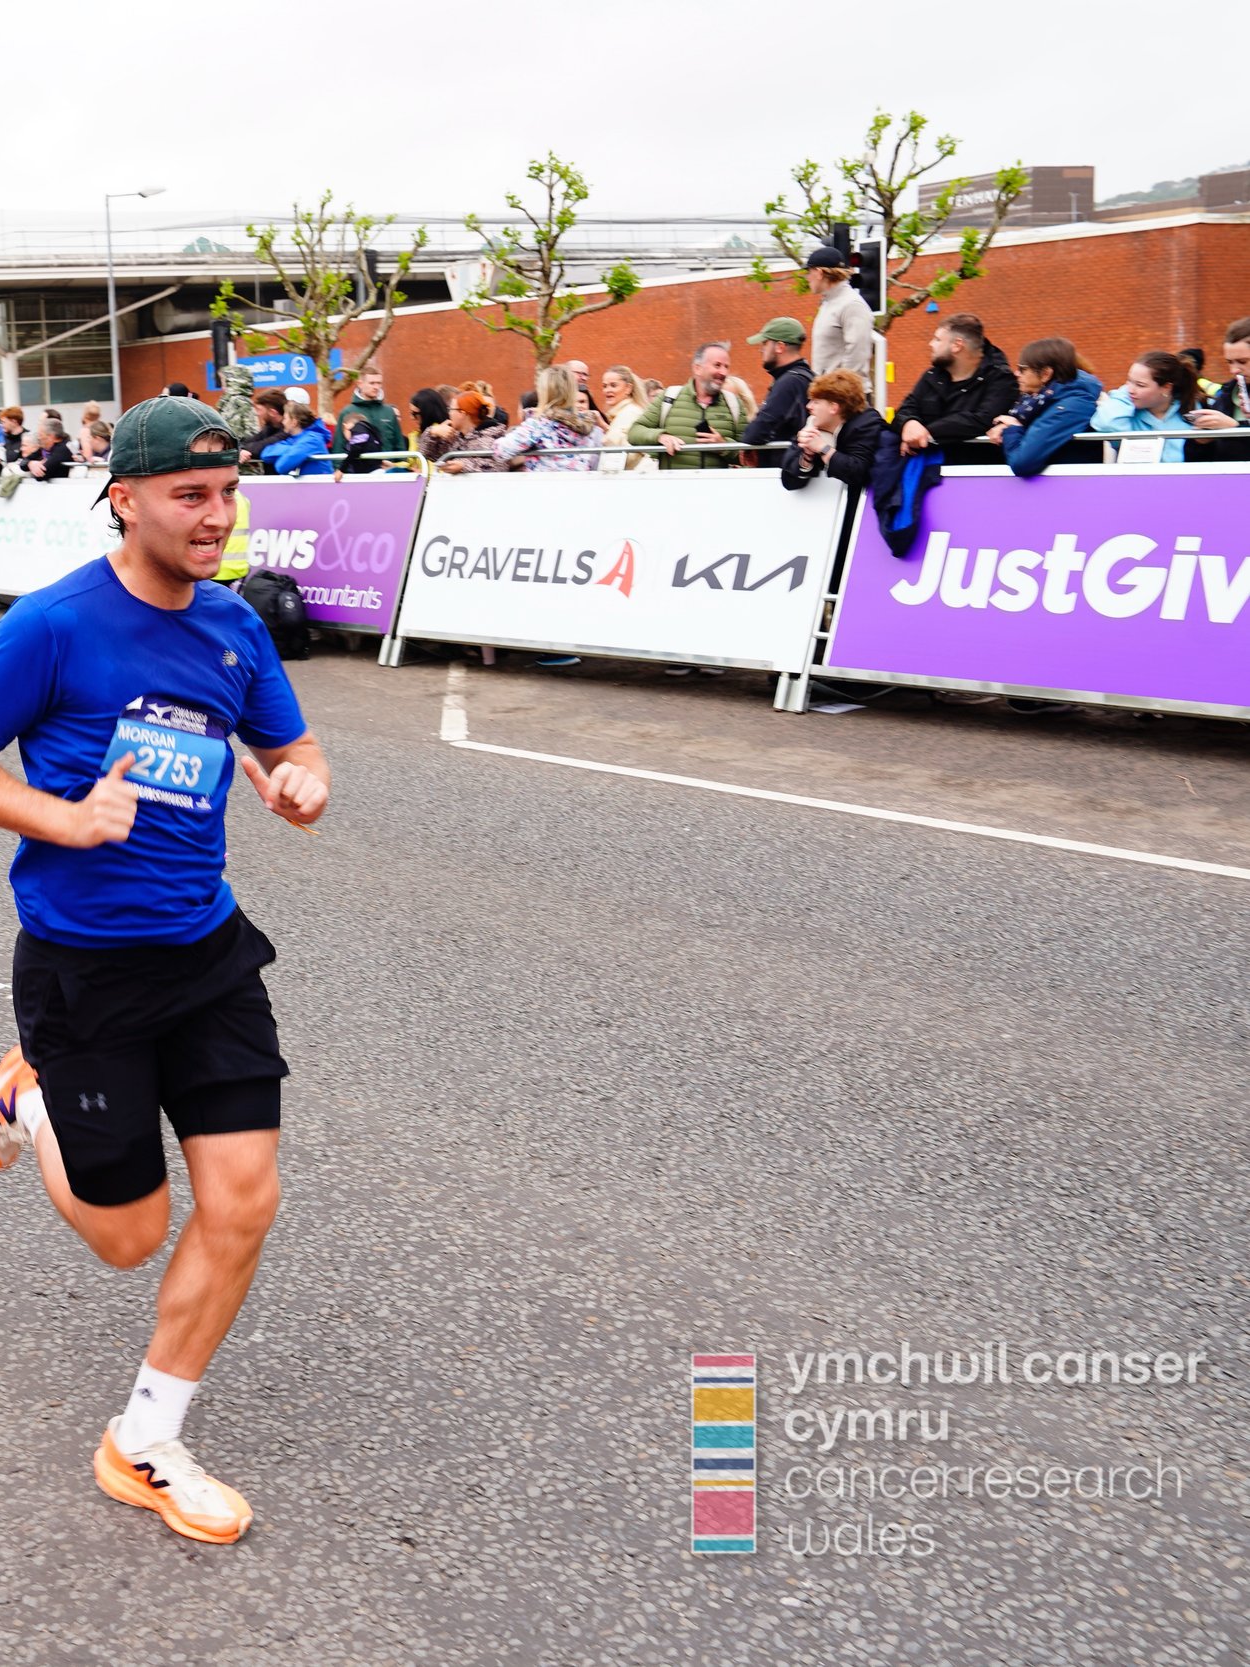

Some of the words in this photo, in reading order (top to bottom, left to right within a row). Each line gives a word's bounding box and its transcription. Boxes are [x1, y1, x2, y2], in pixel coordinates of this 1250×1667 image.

[421, 535, 597, 585] GRAVELLS
[299, 584, 383, 609] ccountants
[117, 724, 176, 750] MORGAN
[130, 745, 203, 788] 2753
